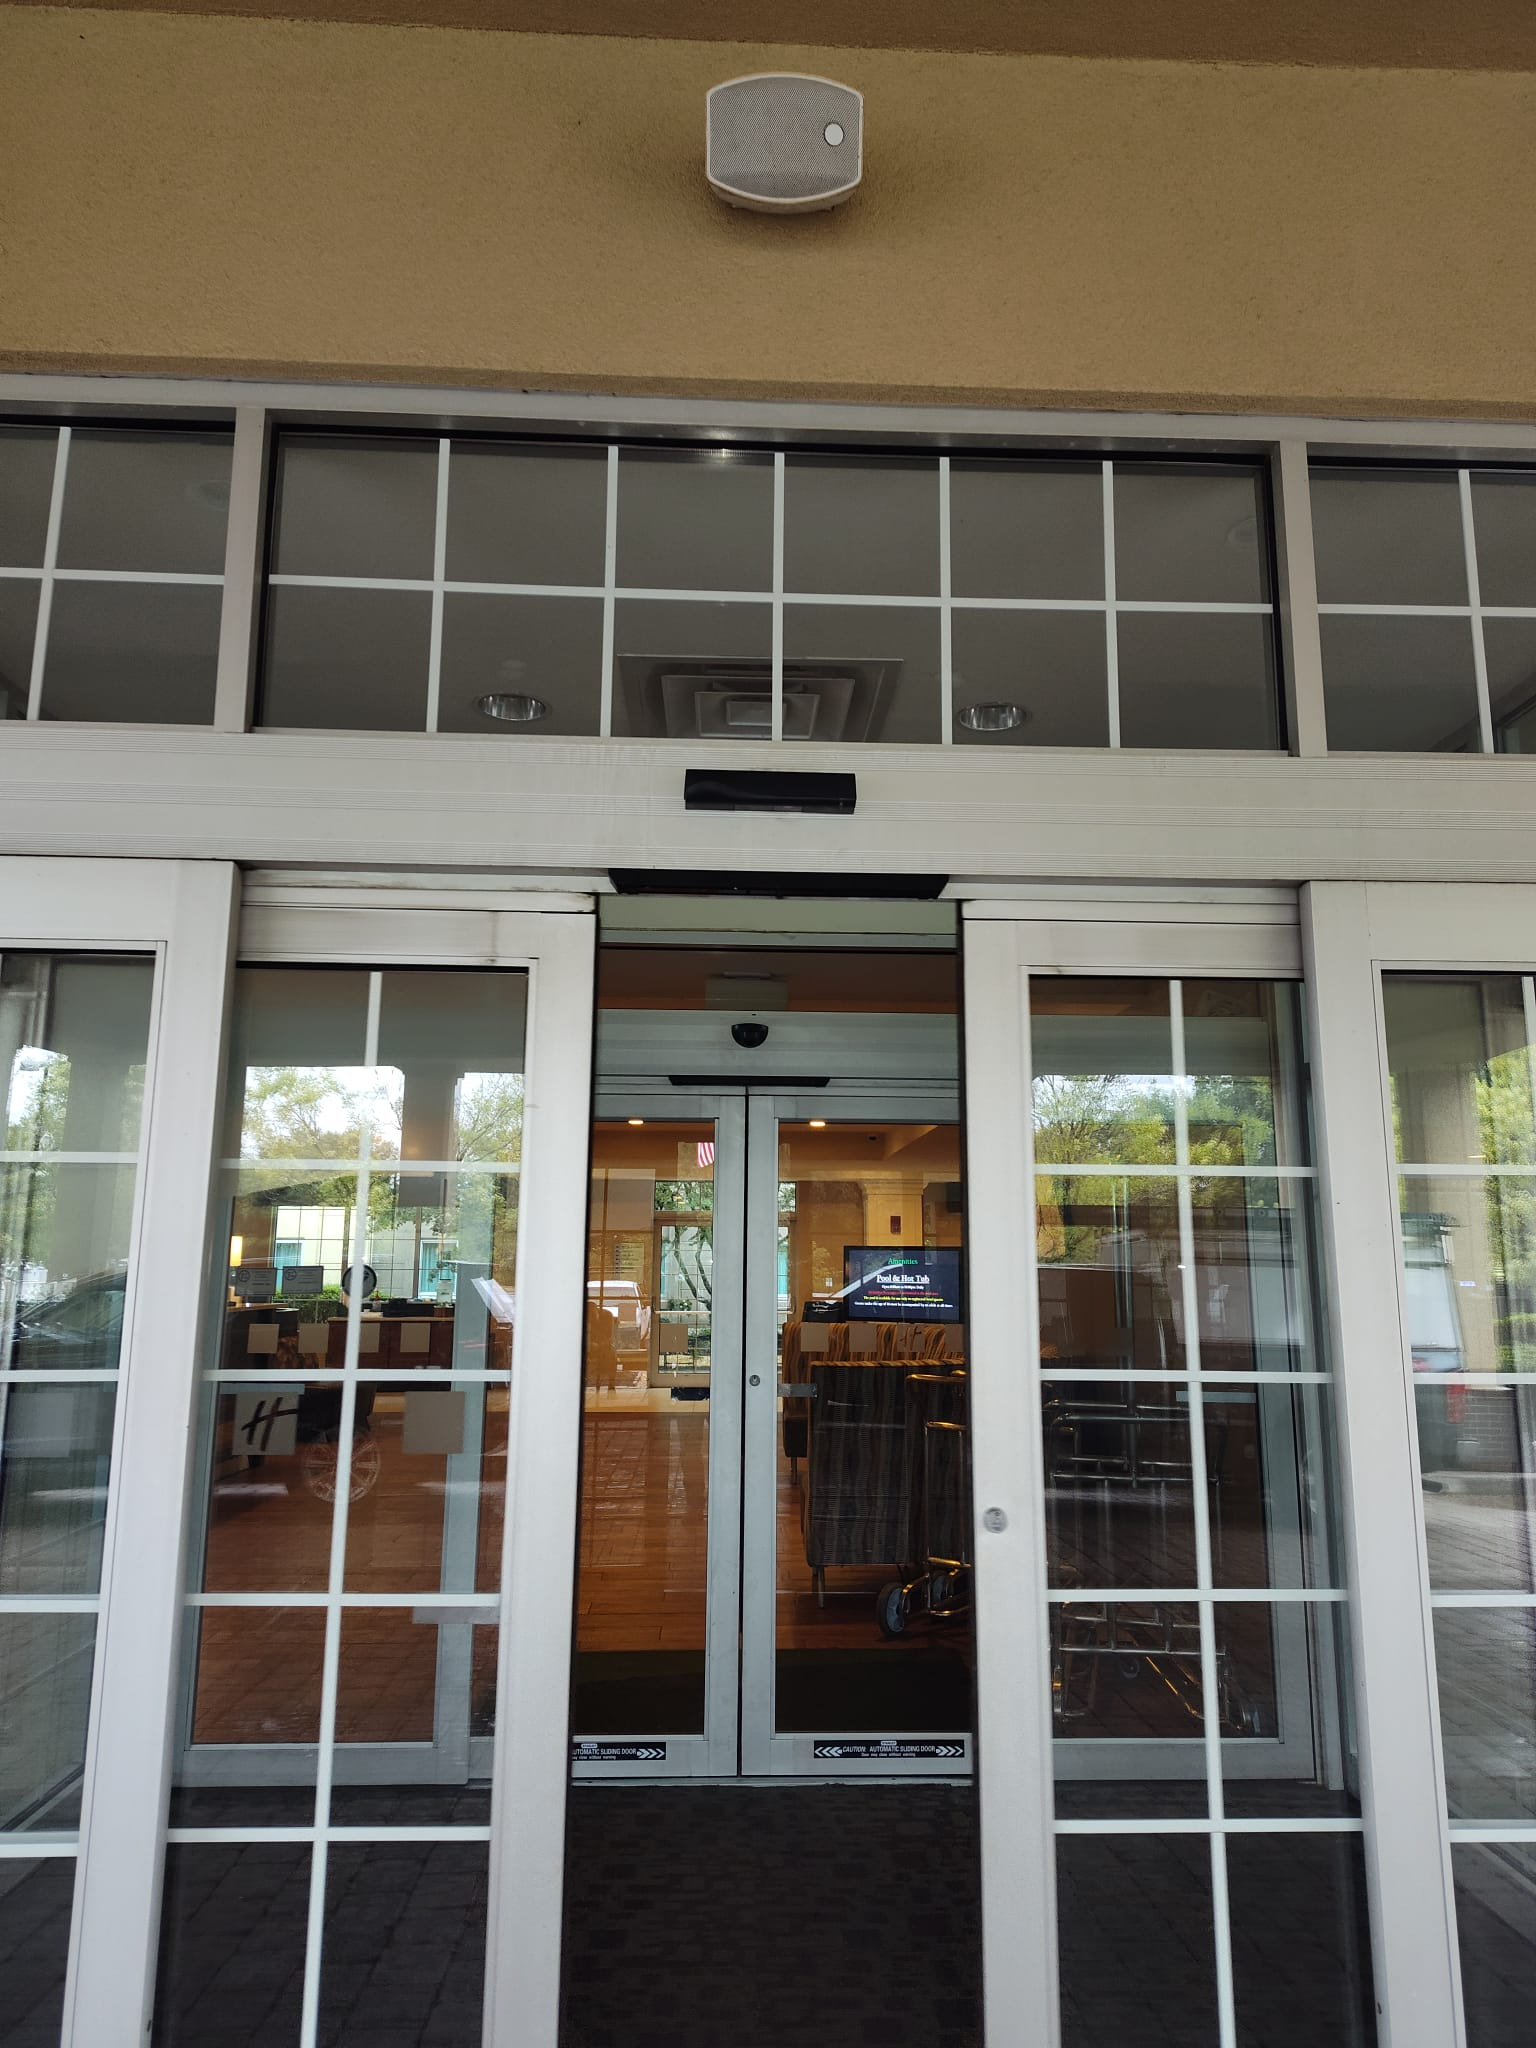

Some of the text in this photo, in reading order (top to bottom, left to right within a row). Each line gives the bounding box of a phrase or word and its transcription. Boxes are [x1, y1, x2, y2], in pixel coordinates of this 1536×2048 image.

[888, 1257, 918, 1265] Amenities
[876, 1274, 930, 1284] Pool & Hot Tub
